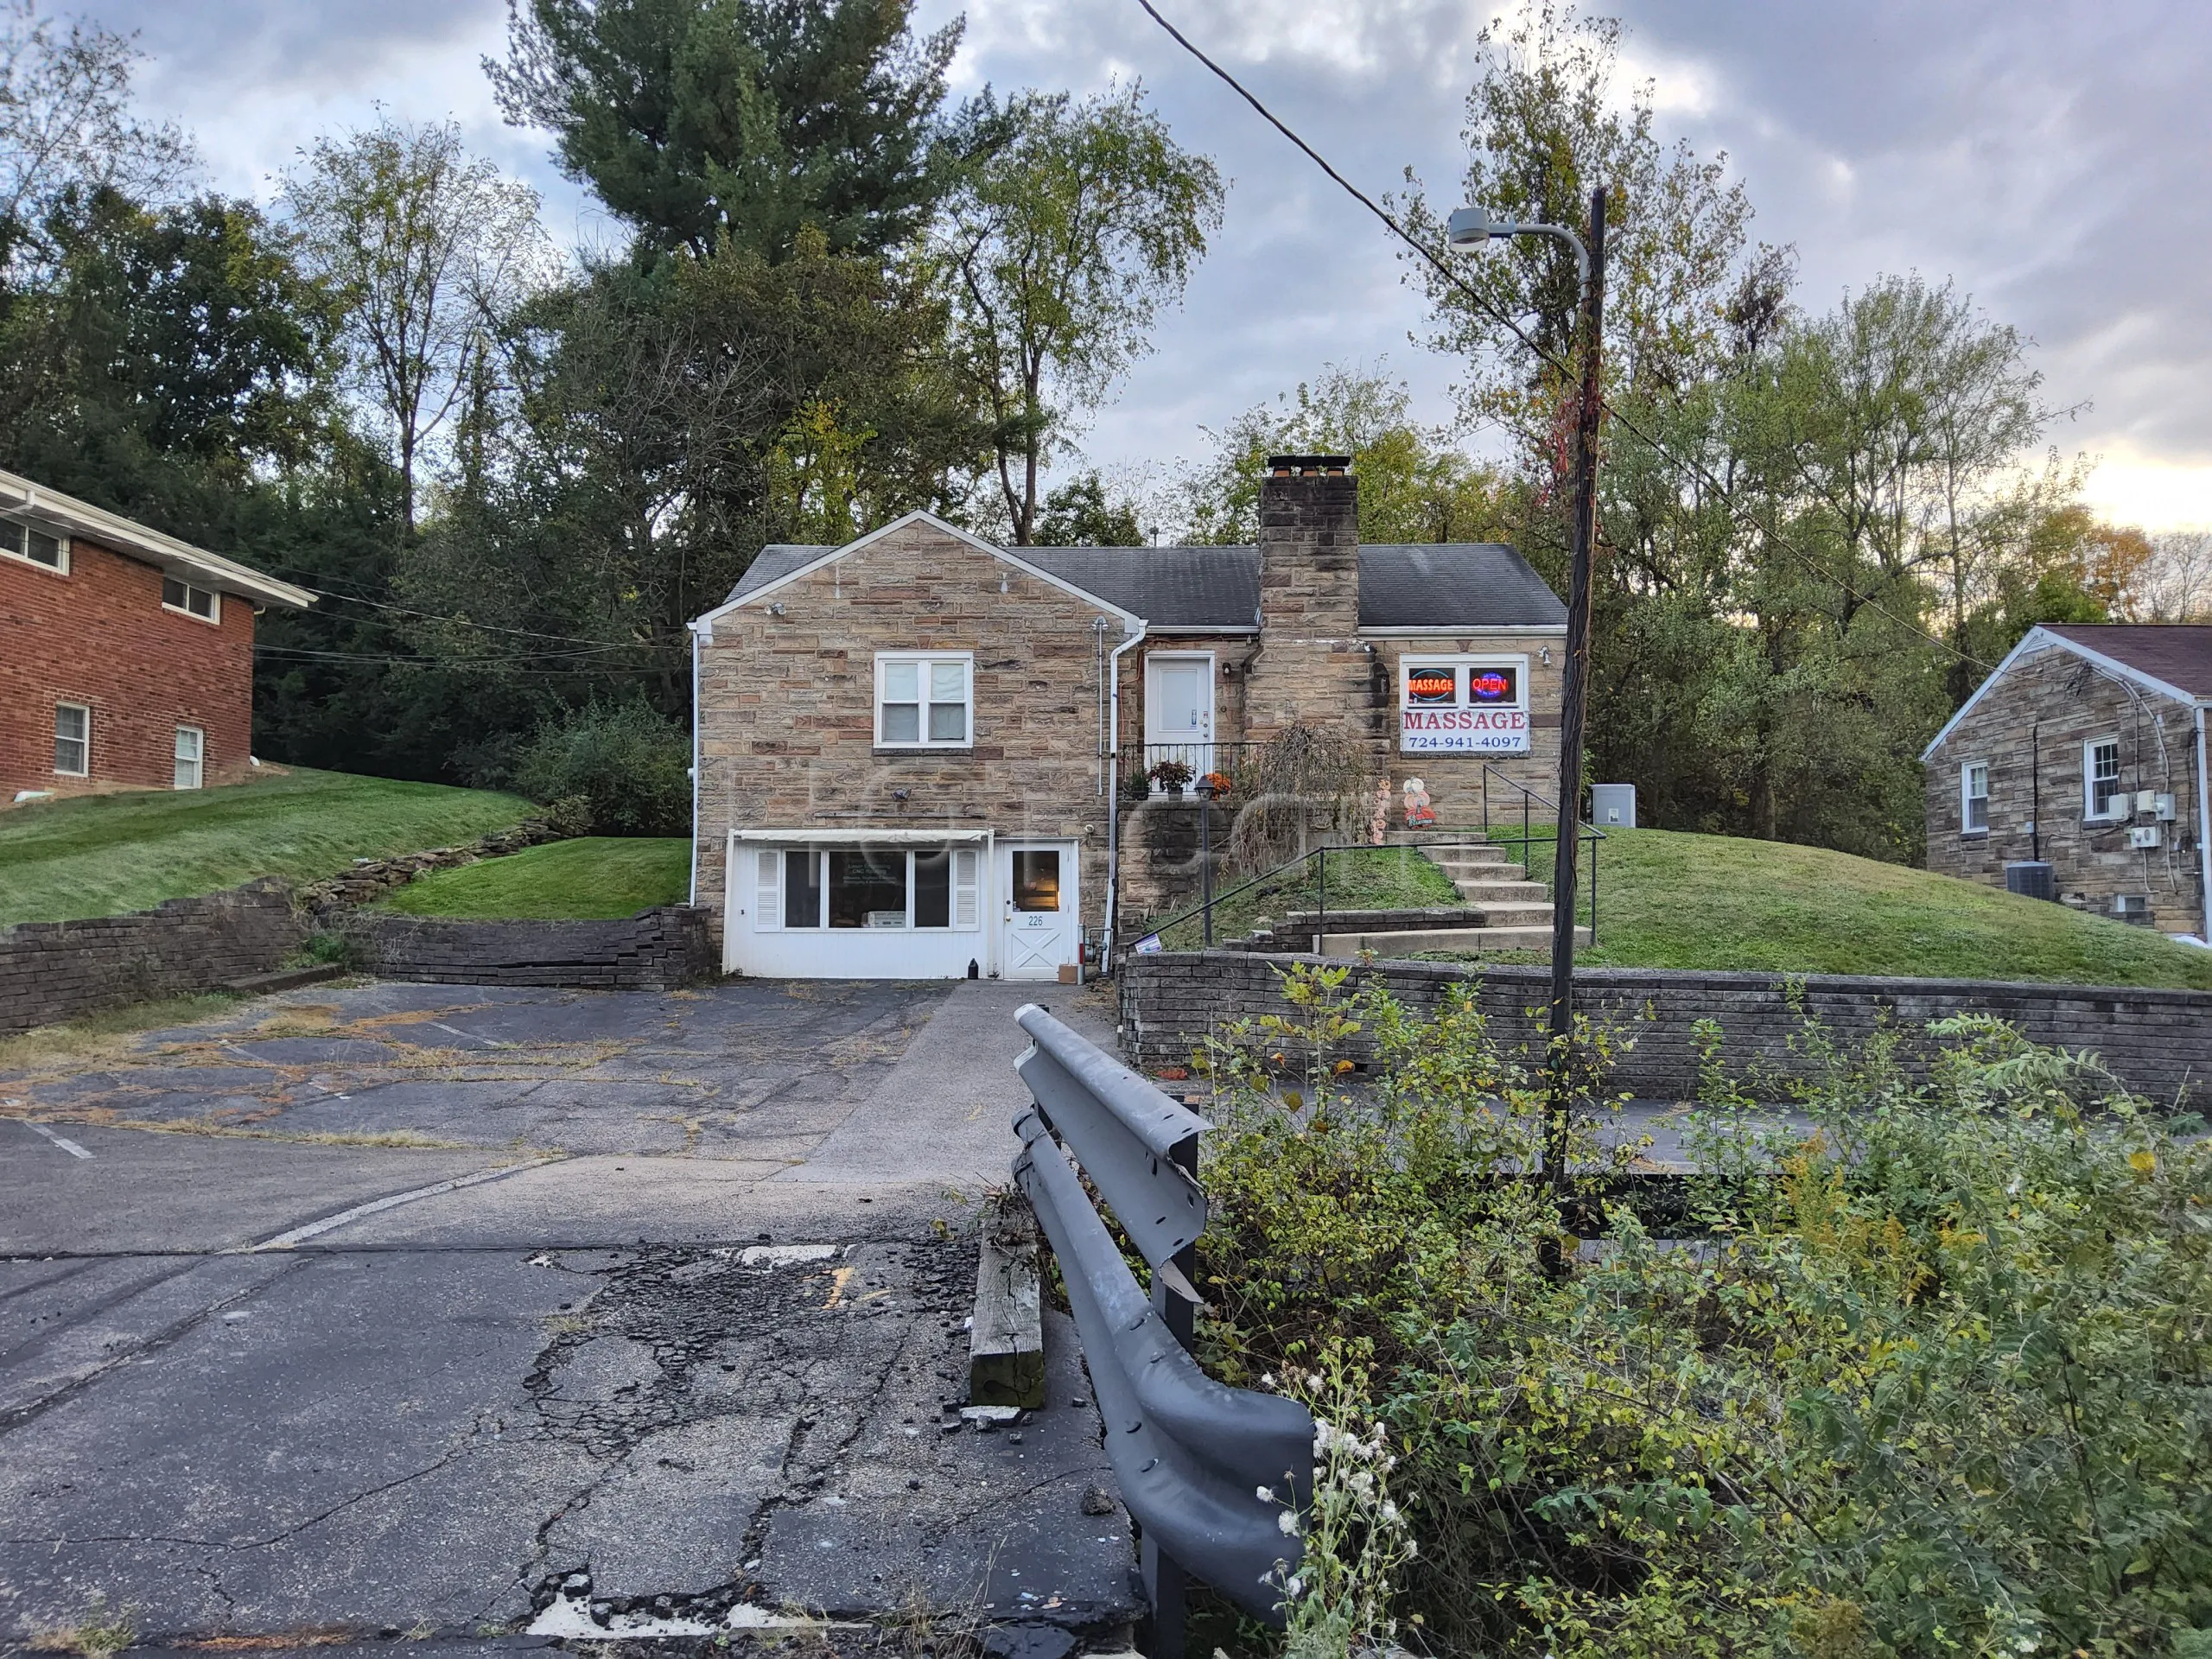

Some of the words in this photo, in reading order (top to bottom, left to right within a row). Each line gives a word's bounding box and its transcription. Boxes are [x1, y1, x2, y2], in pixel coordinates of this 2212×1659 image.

[1408, 678, 1453, 691] MASSAGE
[1472, 678, 1507, 690] OPEN
[1403, 711, 1526, 730] MASSAGE
[1408, 737, 1522, 747] 724-941-4097
[1028, 915, 1043, 926] 226
